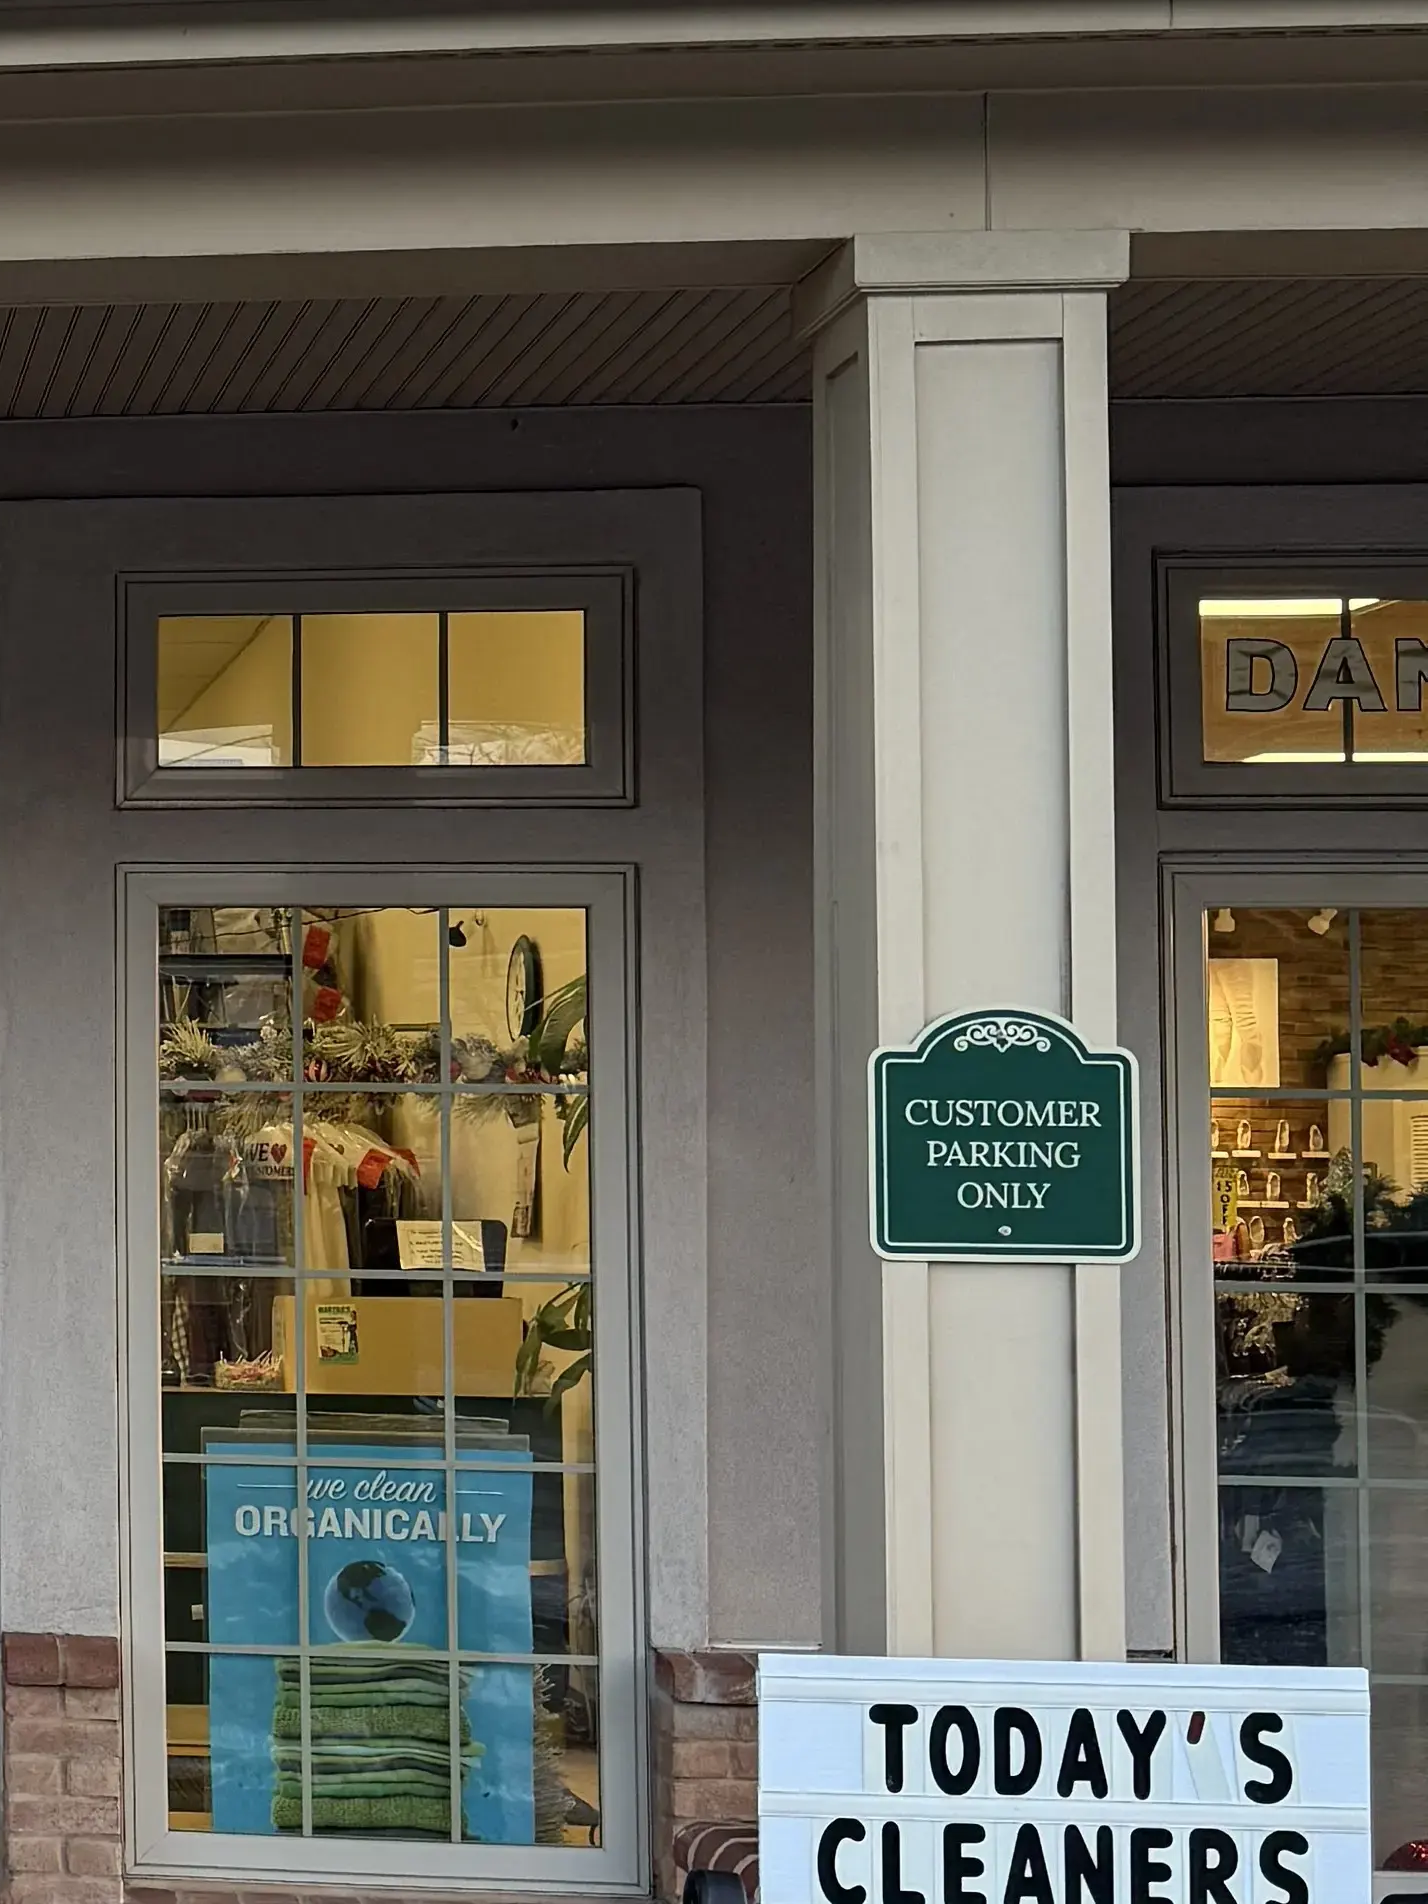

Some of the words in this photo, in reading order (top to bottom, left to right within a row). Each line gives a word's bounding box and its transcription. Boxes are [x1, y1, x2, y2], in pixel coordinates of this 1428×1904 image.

[904, 1099, 1102, 1129] CUSTOMER
[926, 1140, 1082, 1169] PARKING
[956, 1182, 1051, 1210] ONLY
[1216, 1180, 1233, 1192] 15
[305, 1478, 348, 1501] we
[352, 1470, 437, 1504] clean
[234, 1504, 508, 1544] ORGANICALLY
[867, 1703, 1294, 1805] TODAY'S
